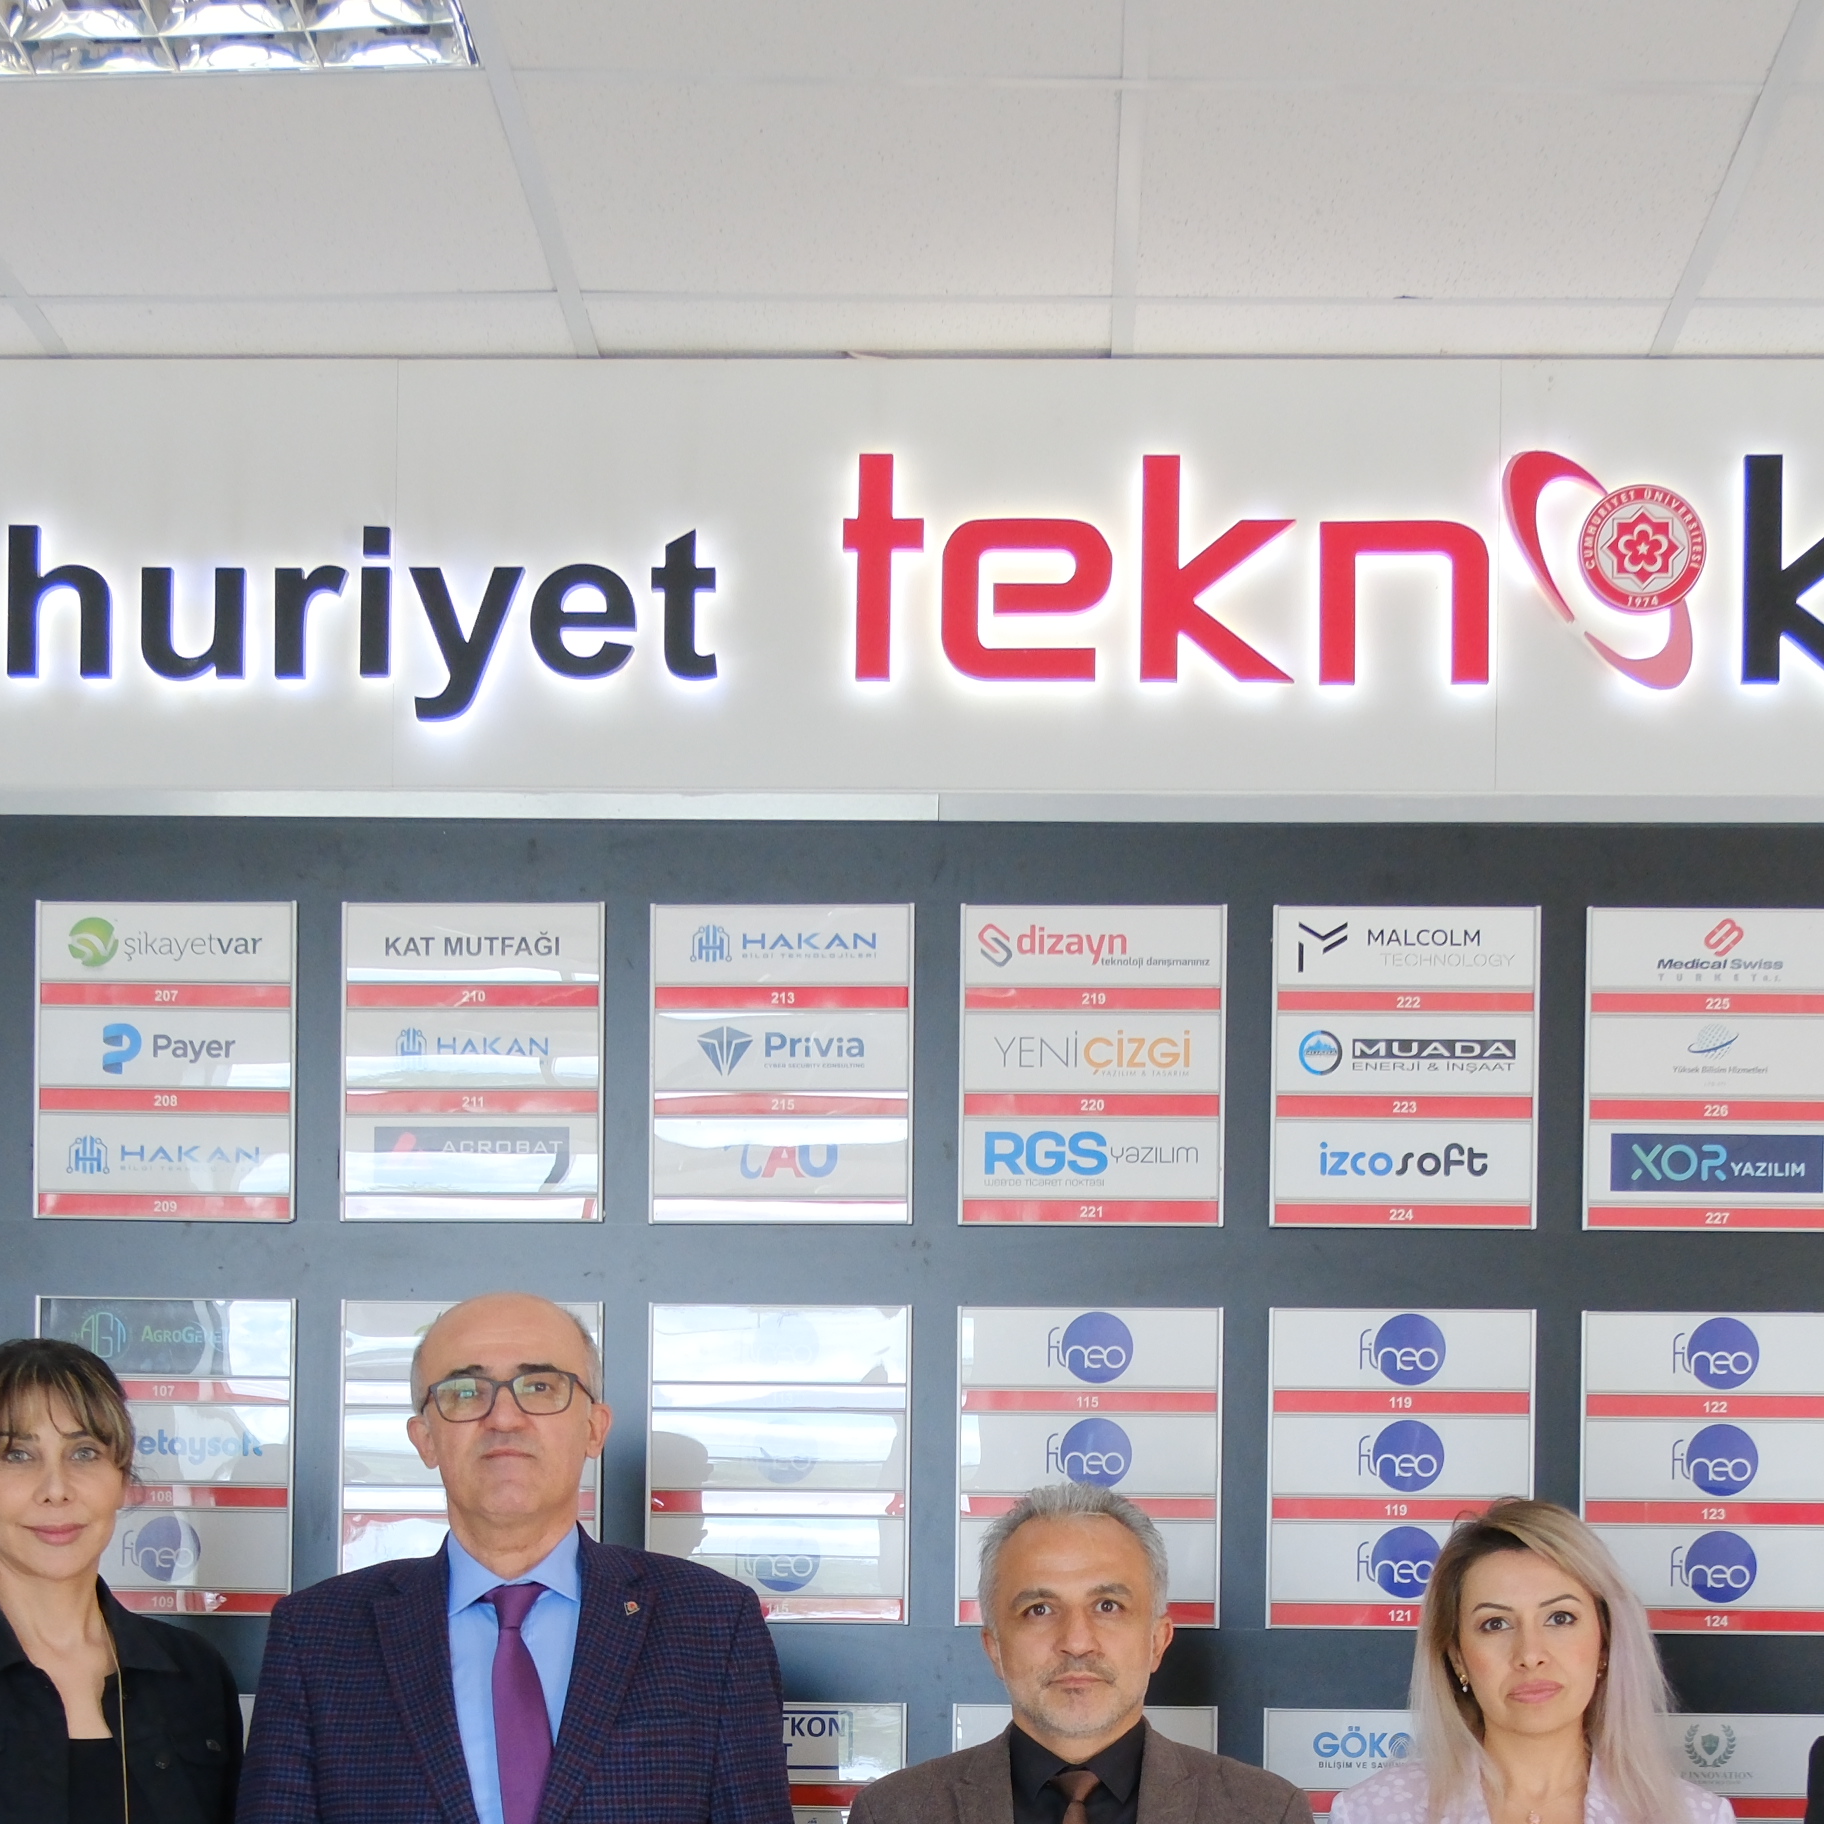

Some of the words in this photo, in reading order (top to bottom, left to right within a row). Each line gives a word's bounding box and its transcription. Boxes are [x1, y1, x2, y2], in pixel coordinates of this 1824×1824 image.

[1627, 595, 1659, 607] 1974
[384, 937, 433, 957] KAT
[443, 930, 561, 957] MUTFAĞI
[742, 932, 877, 950] HAKAN
[1016, 924, 1128, 965] dizayn
[1367, 929, 1481, 947] MALCOLM
[124, 931, 262, 961] şikayetvar
[1101, 957, 1144, 969] teknoloji
[1656, 958, 1728, 969] Medical
[1730, 958, 1783, 969] Swiss
[154, 990, 179, 1003] 207
[461, 990, 486, 1003] 210
[771, 992, 795, 1004] 213
[1082, 993, 1106, 1004] 219
[1396, 997, 1421, 1008] 222
[1705, 998, 1730, 1009] 225
[151, 1034, 236, 1064] Payer
[437, 1037, 549, 1056] HAKAN
[764, 1032, 865, 1058] Privia
[1354, 1041, 1513, 1057] MUADA
[1352, 1061, 1420, 1071] ENERJİ
[1427, 1062, 1438, 1071] &
[1447, 1061, 1515, 1074] İNŞAAT
[153, 1095, 178, 1107] 208
[462, 1096, 484, 1108] 211
[771, 1098, 794, 1111] 215
[1080, 1098, 1104, 1112] 220
[1392, 1101, 1418, 1114] 223
[1704, 1104, 1729, 1117] 226
[441, 1140, 564, 1154] ACROBAT
[984, 1131, 1108, 1176] RGS
[120, 1145, 260, 1163] HAKAN
[1630, 1144, 1727, 1182] XOR
[1730, 1161, 1806, 1178] YAZILIM
[153, 1200, 178, 1213] 209
[1080, 1206, 1103, 1218] 221
[1389, 1208, 1414, 1221] 224
[1704, 1211, 1730, 1224] 227
[152, 1385, 175, 1397] 107
[1076, 1396, 1099, 1409] 115
[1389, 1396, 1412, 1410] 119
[1703, 1400, 1727, 1414] 122
[150, 1490, 173, 1503] 108
[1385, 1503, 1407, 1517] 119
[1701, 1508, 1726, 1520] 123
[152, 1596, 174, 1607] 109
[1388, 1610, 1412, 1623] 121
[1704, 1615, 1729, 1628] 124
[1318, 1761, 1353, 1769] BİLİŞİM
